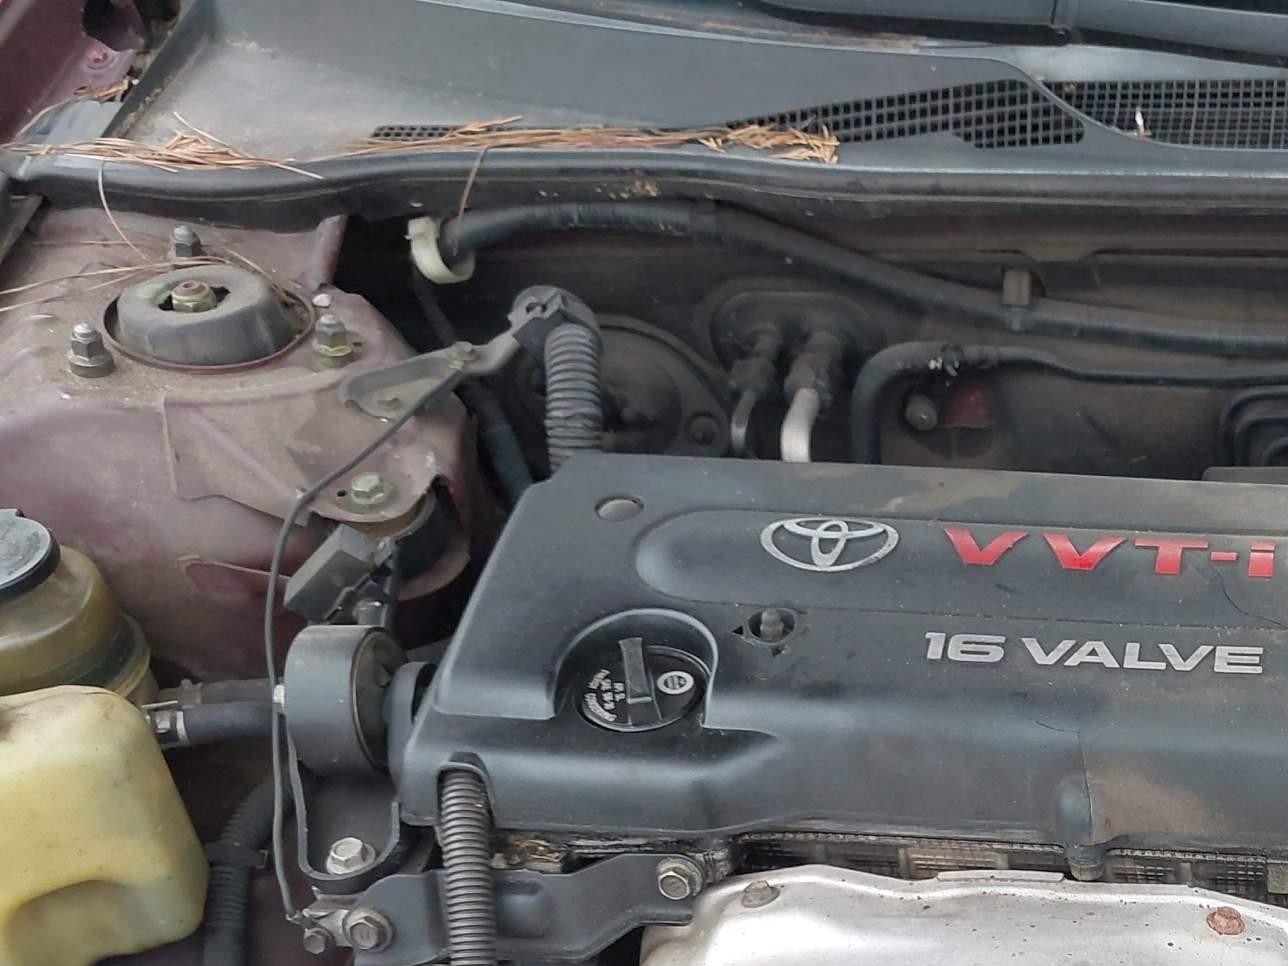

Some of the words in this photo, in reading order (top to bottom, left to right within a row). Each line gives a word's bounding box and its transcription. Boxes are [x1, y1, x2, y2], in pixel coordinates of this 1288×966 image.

[944, 528, 1275, 578] VVT-i
[925, 632, 1005, 663] 16
[1020, 637, 1264, 674] VALVE
